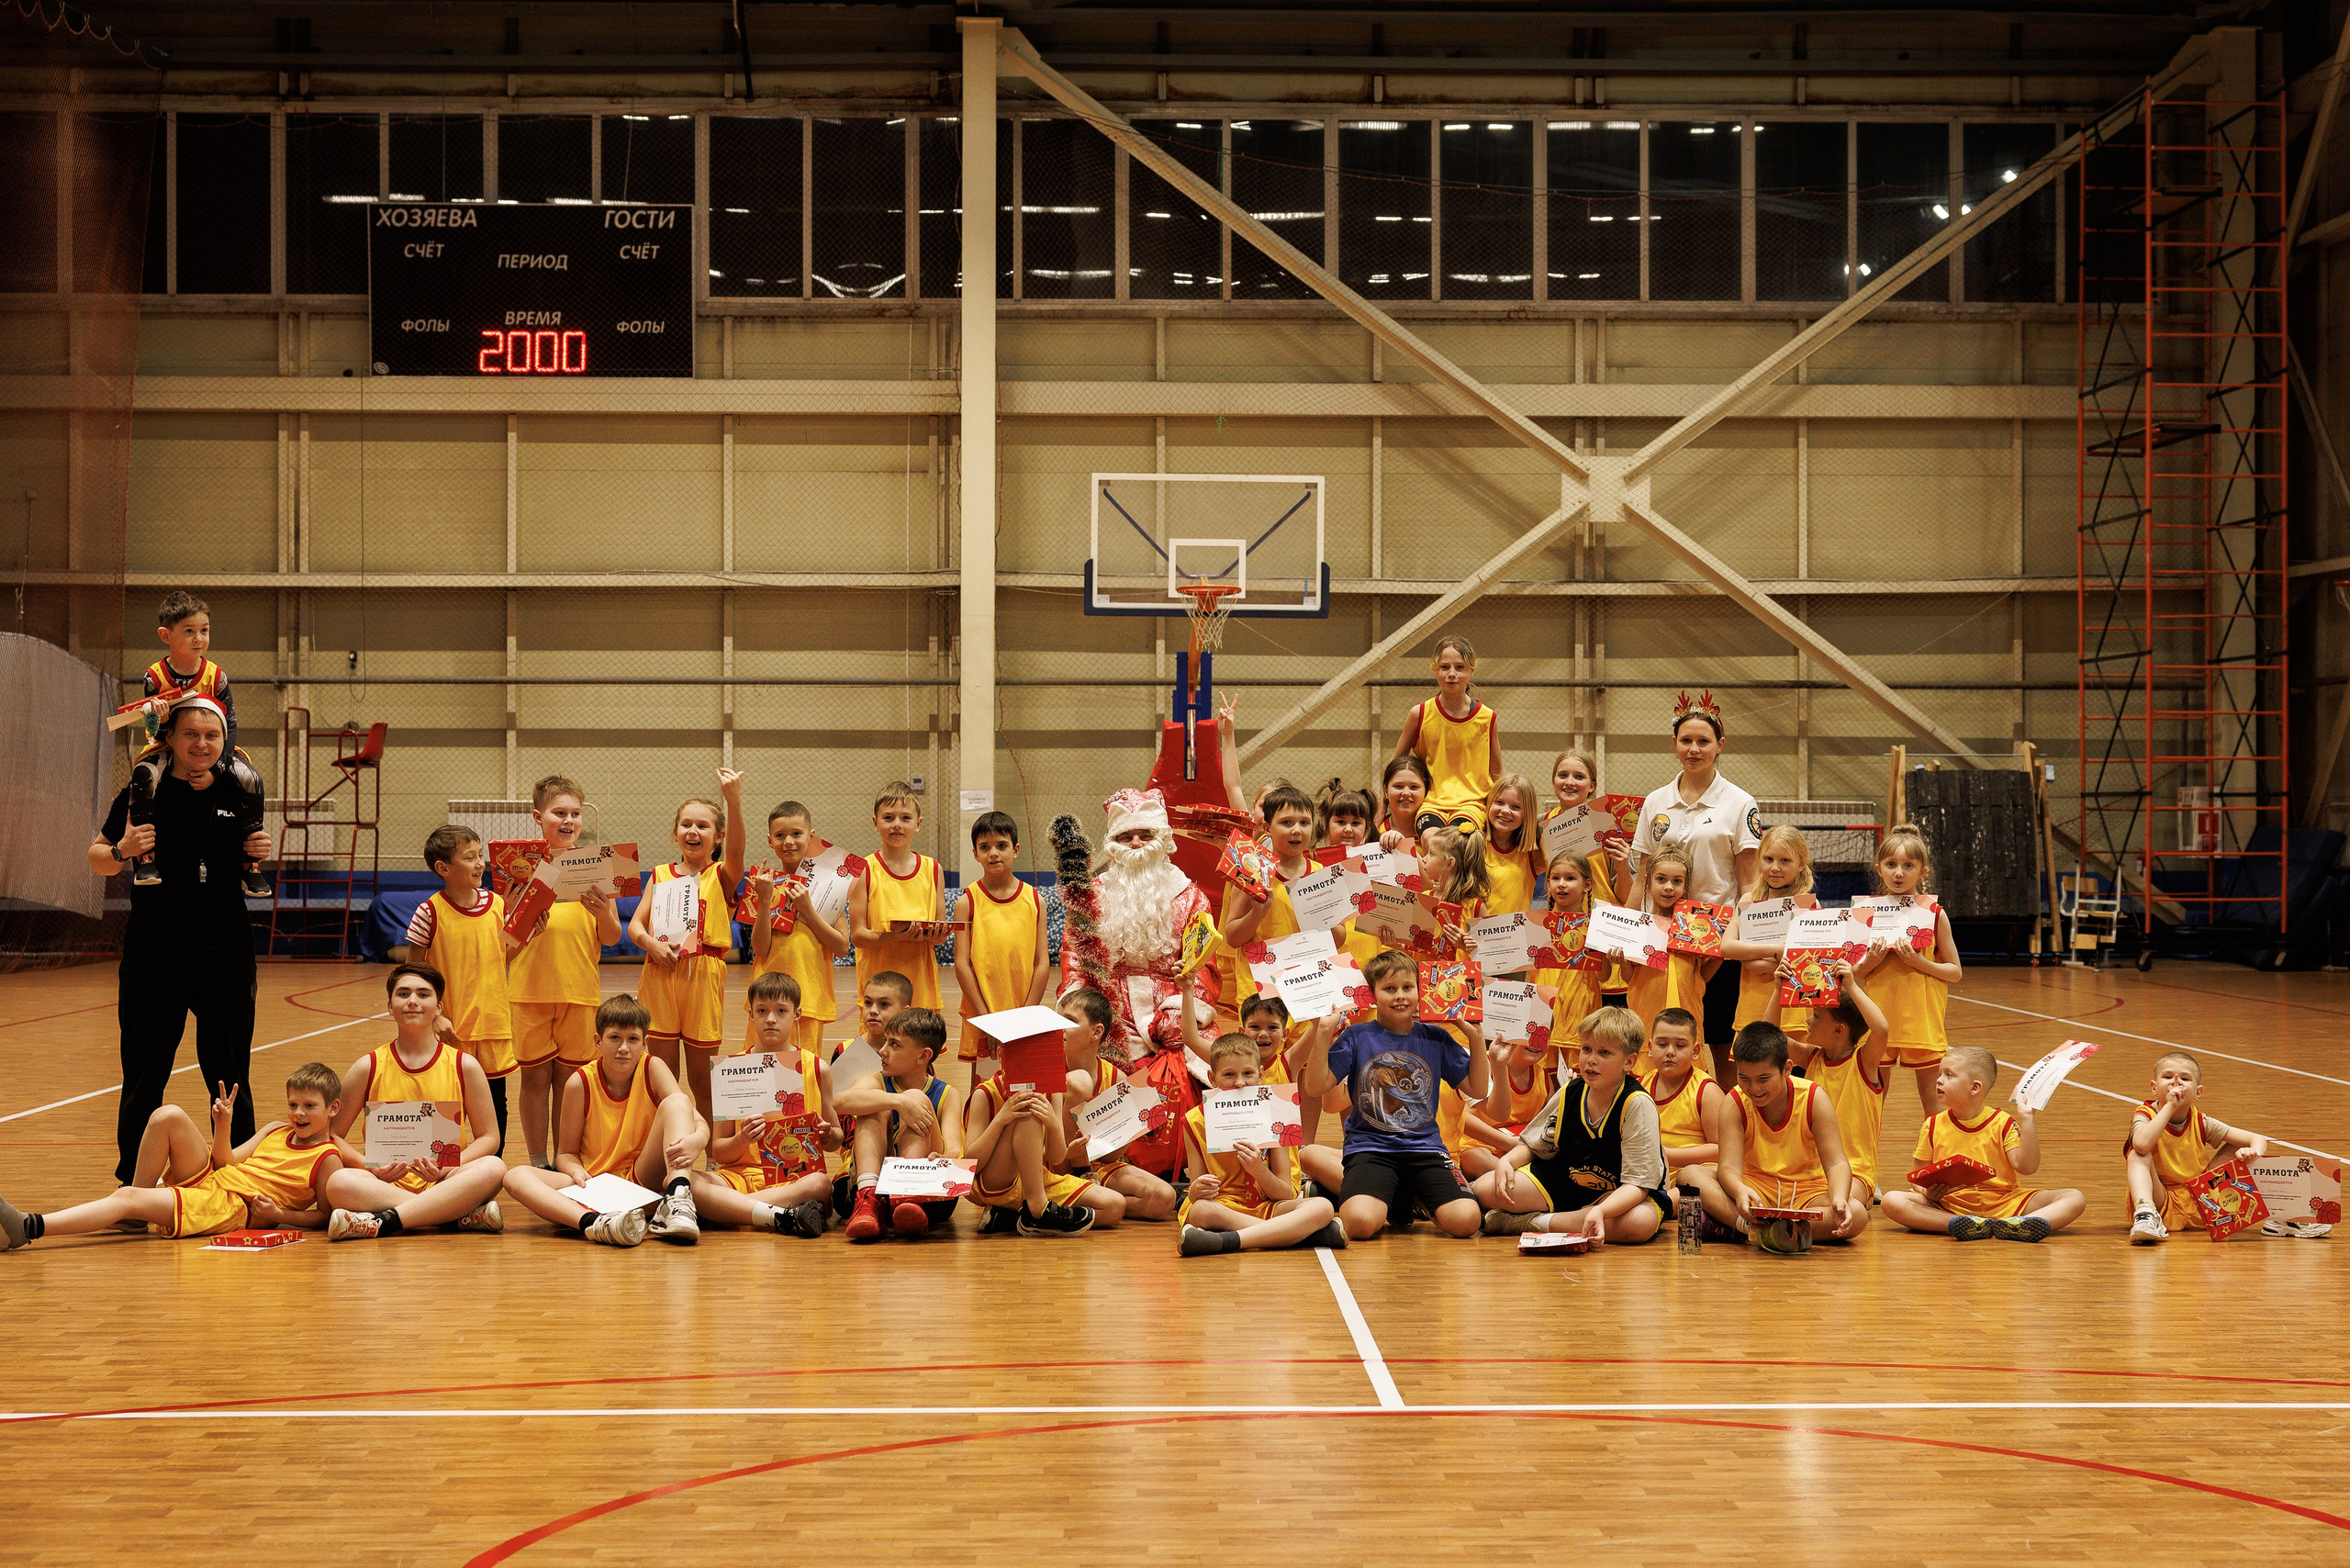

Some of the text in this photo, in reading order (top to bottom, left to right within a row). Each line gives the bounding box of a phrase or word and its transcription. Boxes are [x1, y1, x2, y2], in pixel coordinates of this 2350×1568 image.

[376, 208, 477, 228] ХОЗЯЕВА
[604, 209, 677, 229] ГОСТИ
[404, 241, 444, 258] СЧЁТ
[619, 242, 660, 260] СЧЁТ
[498, 253, 568, 271] ПЕРИОД
[401, 319, 451, 333] ФОЛЫ
[504, 311, 562, 326] ВРЕМЯ
[616, 320, 666, 334] ФОЛЫ
[479, 330, 587, 373] 2000
[217, 809, 236, 817] FILA
[1549, 817, 1582, 834] ГРАМОТА
[561, 857, 602, 866] ГРАМОТА
[1362, 854, 1384, 862] МОТА
[1297, 879, 1336, 896] ГРАМОТА
[682, 884, 690, 923] ГРАМОТА
[1373, 891, 1405, 906] РАМОТА
[1601, 911, 1640, 927] ГРАМОТА
[1747, 910, 1785, 921] ГРАМОТА
[1477, 925, 1516, 936] ГРАМОТА
[1283, 971, 1324, 986] ГРАМОТА
[1488, 990, 1524, 1002] ГРАМОТА
[721, 1066, 765, 1076] ГРАМОТА
[1085, 1097, 1123, 1122] ГРАМОТА
[1214, 1099, 1259, 1109] ГРАМОТА
[377, 1114, 422, 1123] ГРАМОТА
[1592, 1165, 1617, 1182] STATE
[2253, 1168, 2300, 1177] ГРАМОТА
